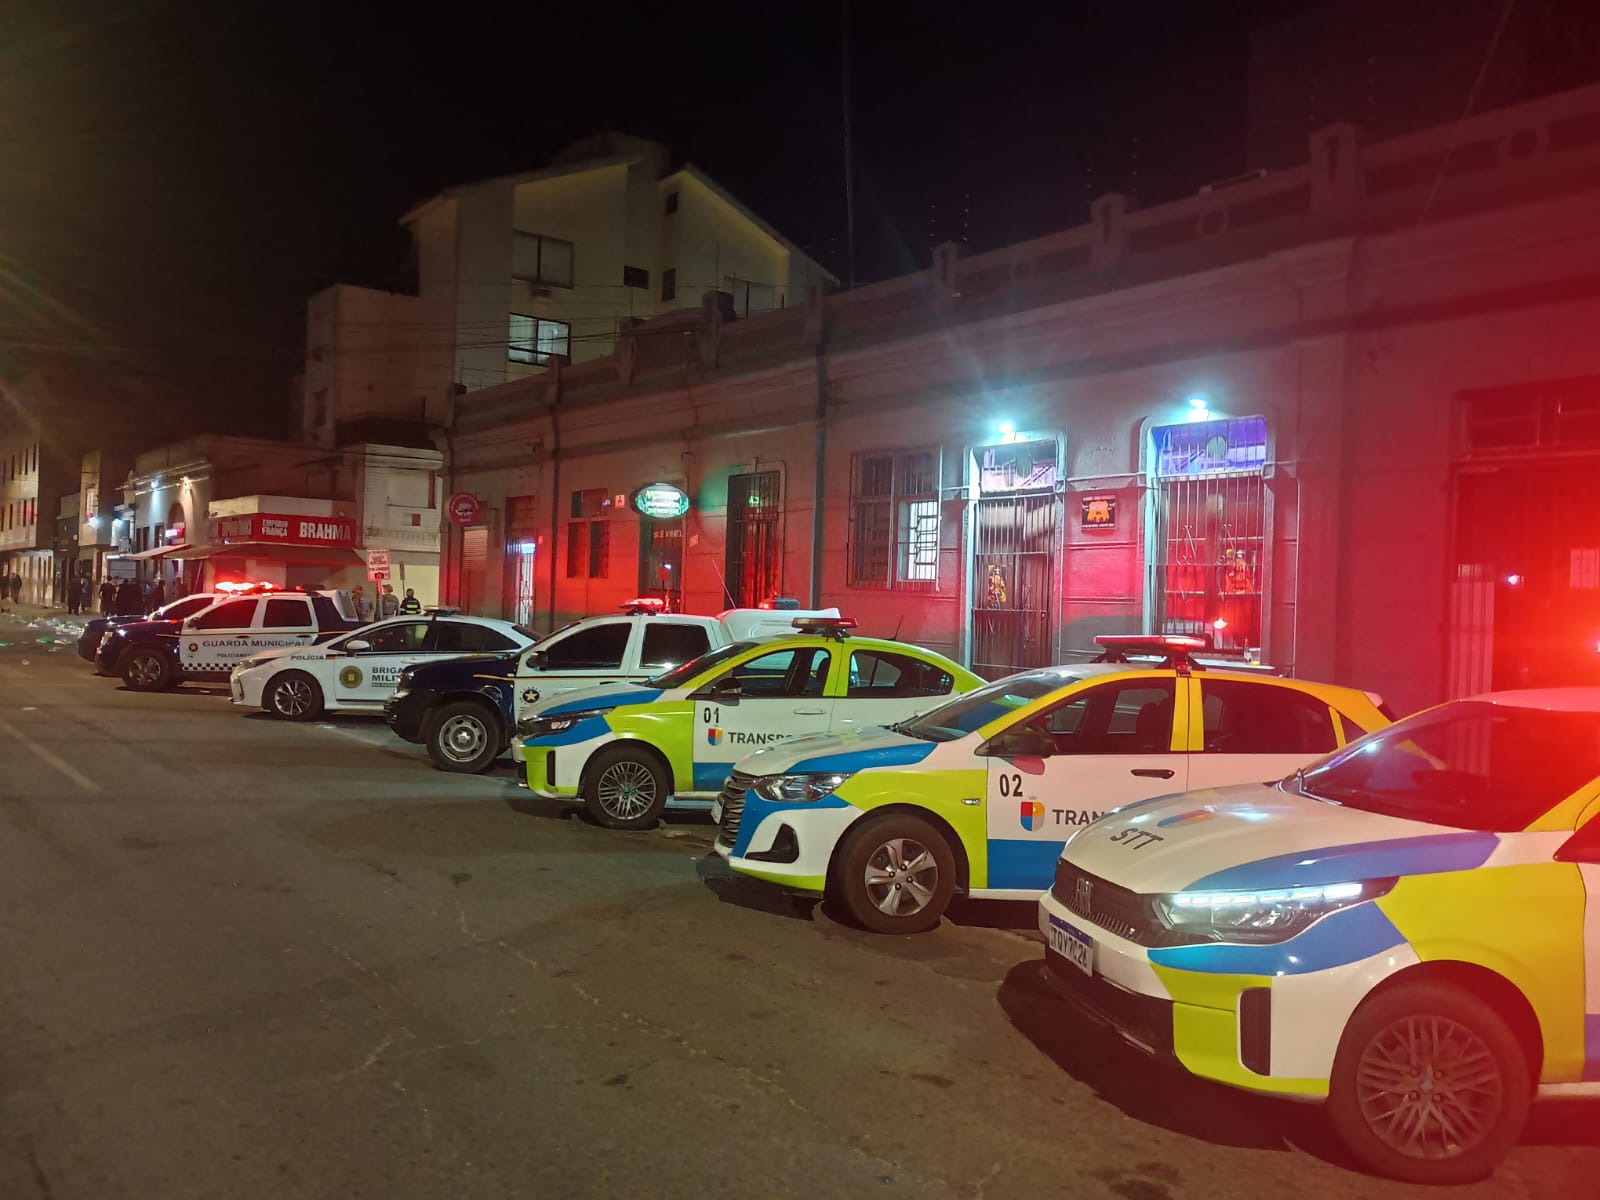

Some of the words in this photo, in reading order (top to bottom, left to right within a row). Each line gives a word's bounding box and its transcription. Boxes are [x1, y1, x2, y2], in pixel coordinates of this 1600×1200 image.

[299, 522, 351, 541] BRAHMA
[703, 707, 719, 724] 01
[999, 773, 1024, 797] 02
[1110, 827, 1164, 849] STT
